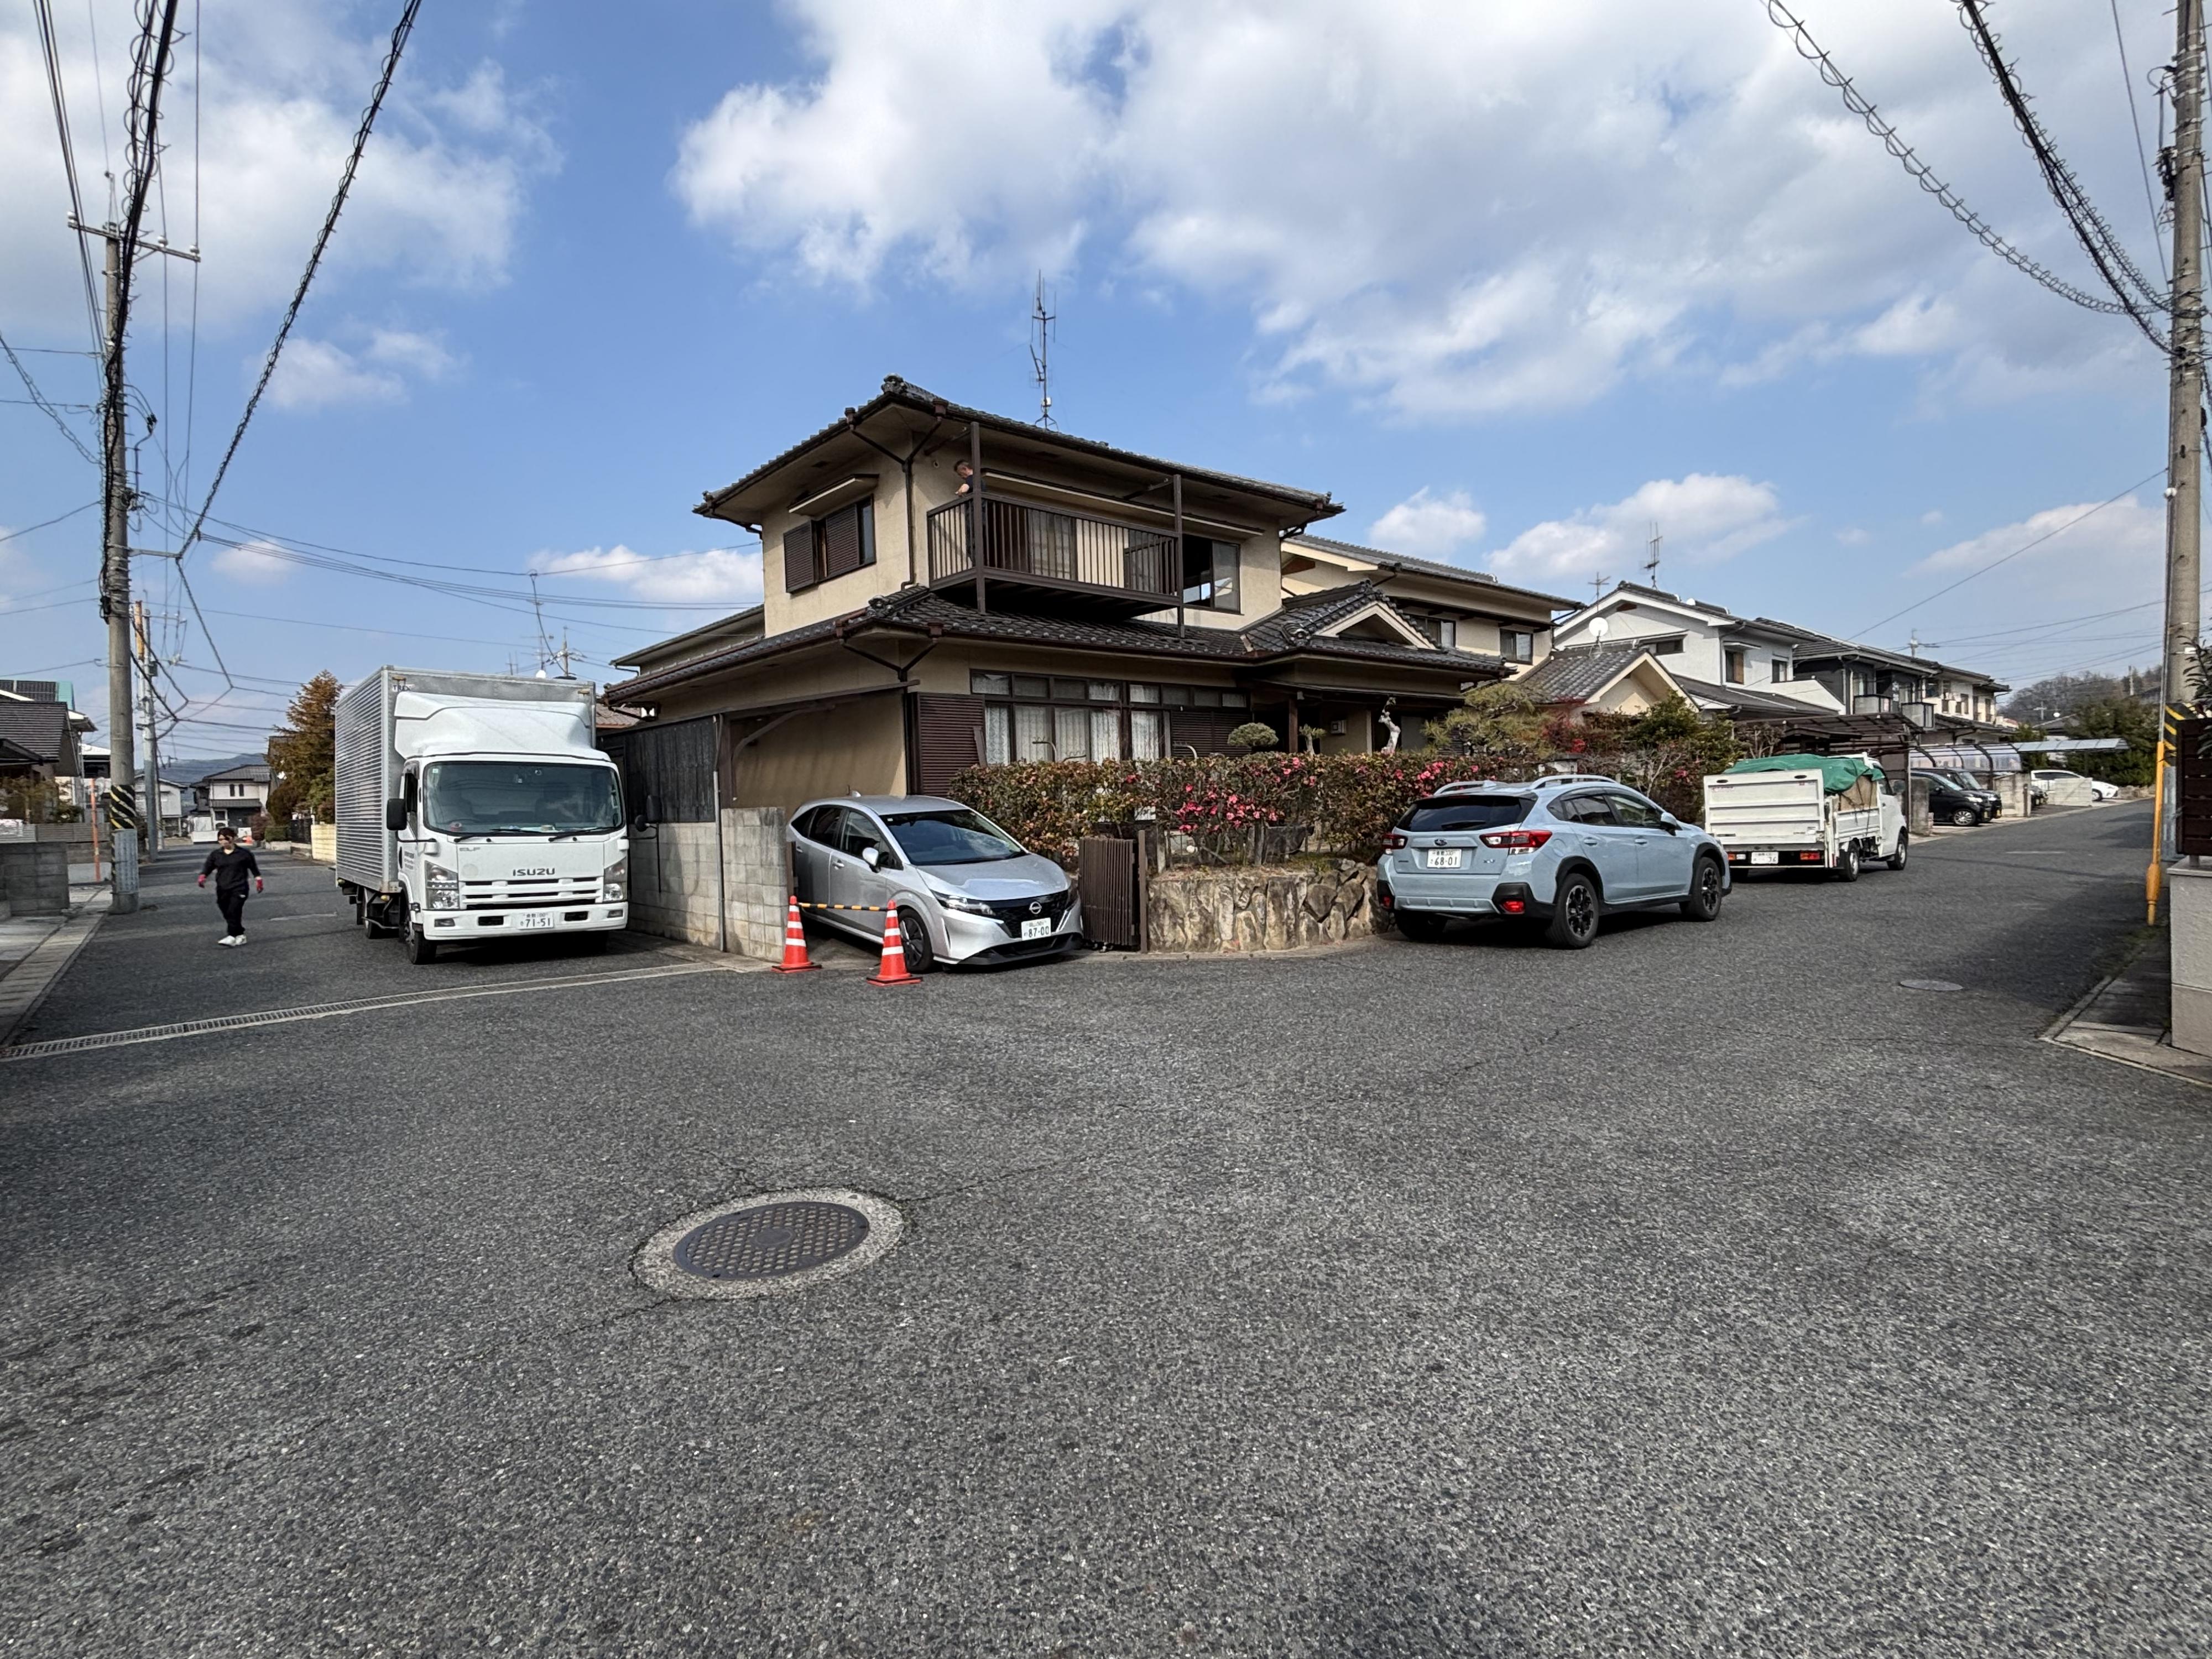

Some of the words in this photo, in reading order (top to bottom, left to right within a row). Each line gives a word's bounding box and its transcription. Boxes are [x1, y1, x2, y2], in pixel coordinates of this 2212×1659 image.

[1434, 857, 1457, 865] 68-01
[513, 868, 555, 877] ISUZU
[525, 918, 550, 927] 71-51
[1028, 926, 1050, 938] 87-00
